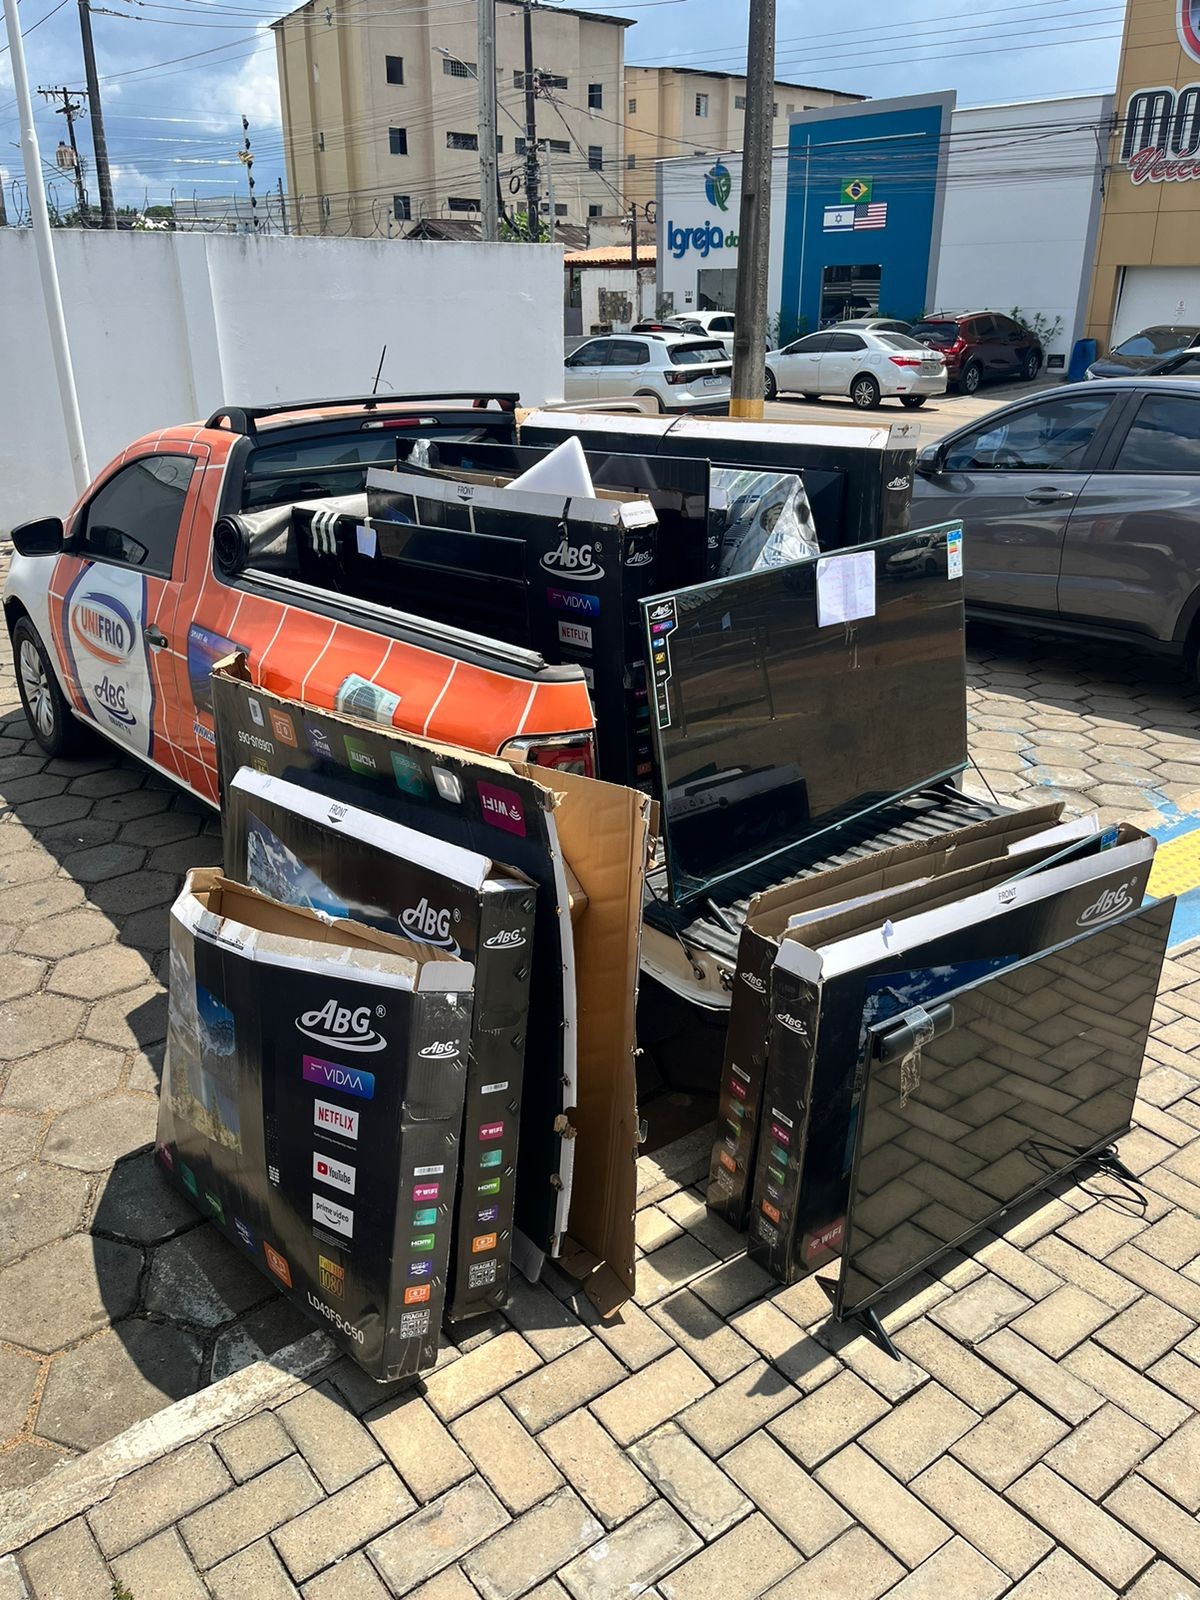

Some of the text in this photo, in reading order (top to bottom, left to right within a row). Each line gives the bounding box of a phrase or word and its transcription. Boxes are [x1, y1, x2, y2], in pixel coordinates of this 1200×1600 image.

[667, 220, 724, 258] Igreja
[457, 486, 474, 496] FRONT
[543, 541, 592, 567] ABG
[626, 551, 649, 563] ABG
[81, 606, 124, 649] UNIFRIO
[561, 626, 589, 643] NETFLIX
[94, 676, 126, 709] ABG
[329, 803, 348, 818] FRONT
[482, 795, 508, 816] WiFi
[999, 887, 1016, 899] FRONT
[1081, 883, 1128, 920] ABG
[402, 897, 451, 937] ABG
[486, 929, 520, 945] ABG
[742, 972, 762, 987] ABG
[301, 999, 371, 1034] ABG
[777, 1013, 801, 1028] ABG
[420, 1041, 453, 1054] ABG
[318, 1106, 354, 1132] NETFLIX
[329, 1166, 351, 1185] YouTube
[316, 1202, 349, 1223] prime video
[471, 1262, 494, 1272] FRAGILE
[320, 1269, 344, 1297] 1080
[307, 1291, 365, 1345] LD43FS-C50
[403, 1312, 429, 1321] FRAGILE
